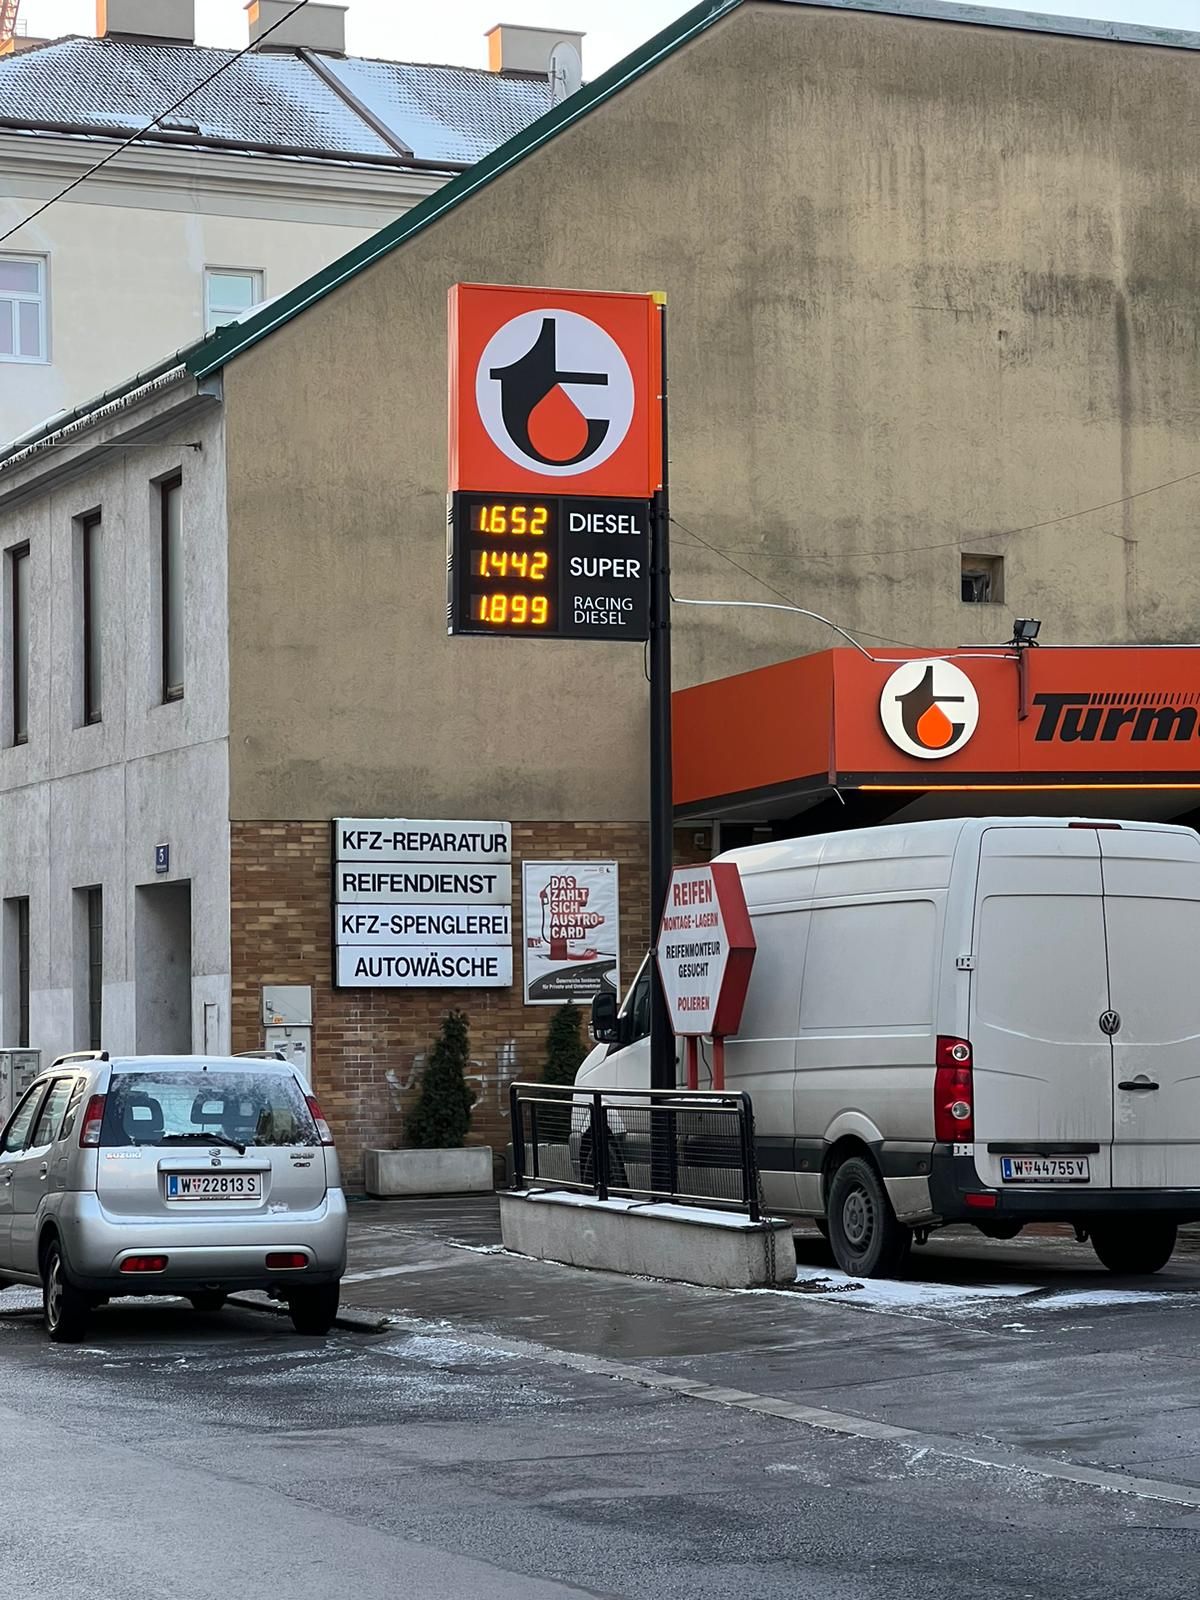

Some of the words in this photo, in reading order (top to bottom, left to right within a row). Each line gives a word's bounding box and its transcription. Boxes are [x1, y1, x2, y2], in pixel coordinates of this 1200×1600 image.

[480, 505, 548, 534] 1.652
[569, 512, 641, 535] DIESEL
[480, 551, 548, 579] 1.442
[569, 557, 641, 578] SUPER
[479, 595, 548, 624] 1.899
[574, 596, 633, 611] RACING
[574, 610, 626, 625] DIESEL
[342, 830, 507, 853] KFZ-REPARATUR
[342, 873, 497, 894] REIFENDIENST
[551, 877, 574, 889] DAS
[551, 889, 587, 901] ZAHLT
[673, 880, 712, 906] REIFEN
[551, 901, 578, 913] SICH
[342, 915, 508, 935] KFZ-SPENGLEREI
[552, 914, 603, 926] AUSTRO-
[551, 927, 583, 939] CARD
[666, 941, 721, 959] REIFENMONTEUR
[355, 952, 498, 977] AUTOWÄSCHE
[678, 962, 709, 978] GESUCHT
[677, 997, 710, 1011] POLIEREN
[1013, 1161, 1023, 1175] W
[1034, 1161, 1074, 1175] 44755
[1076, 1161, 1084, 1175] V
[181, 1178, 191, 1192] W
[202, 1178, 244, 1192] 22813
[247, 1177, 255, 1192] S
